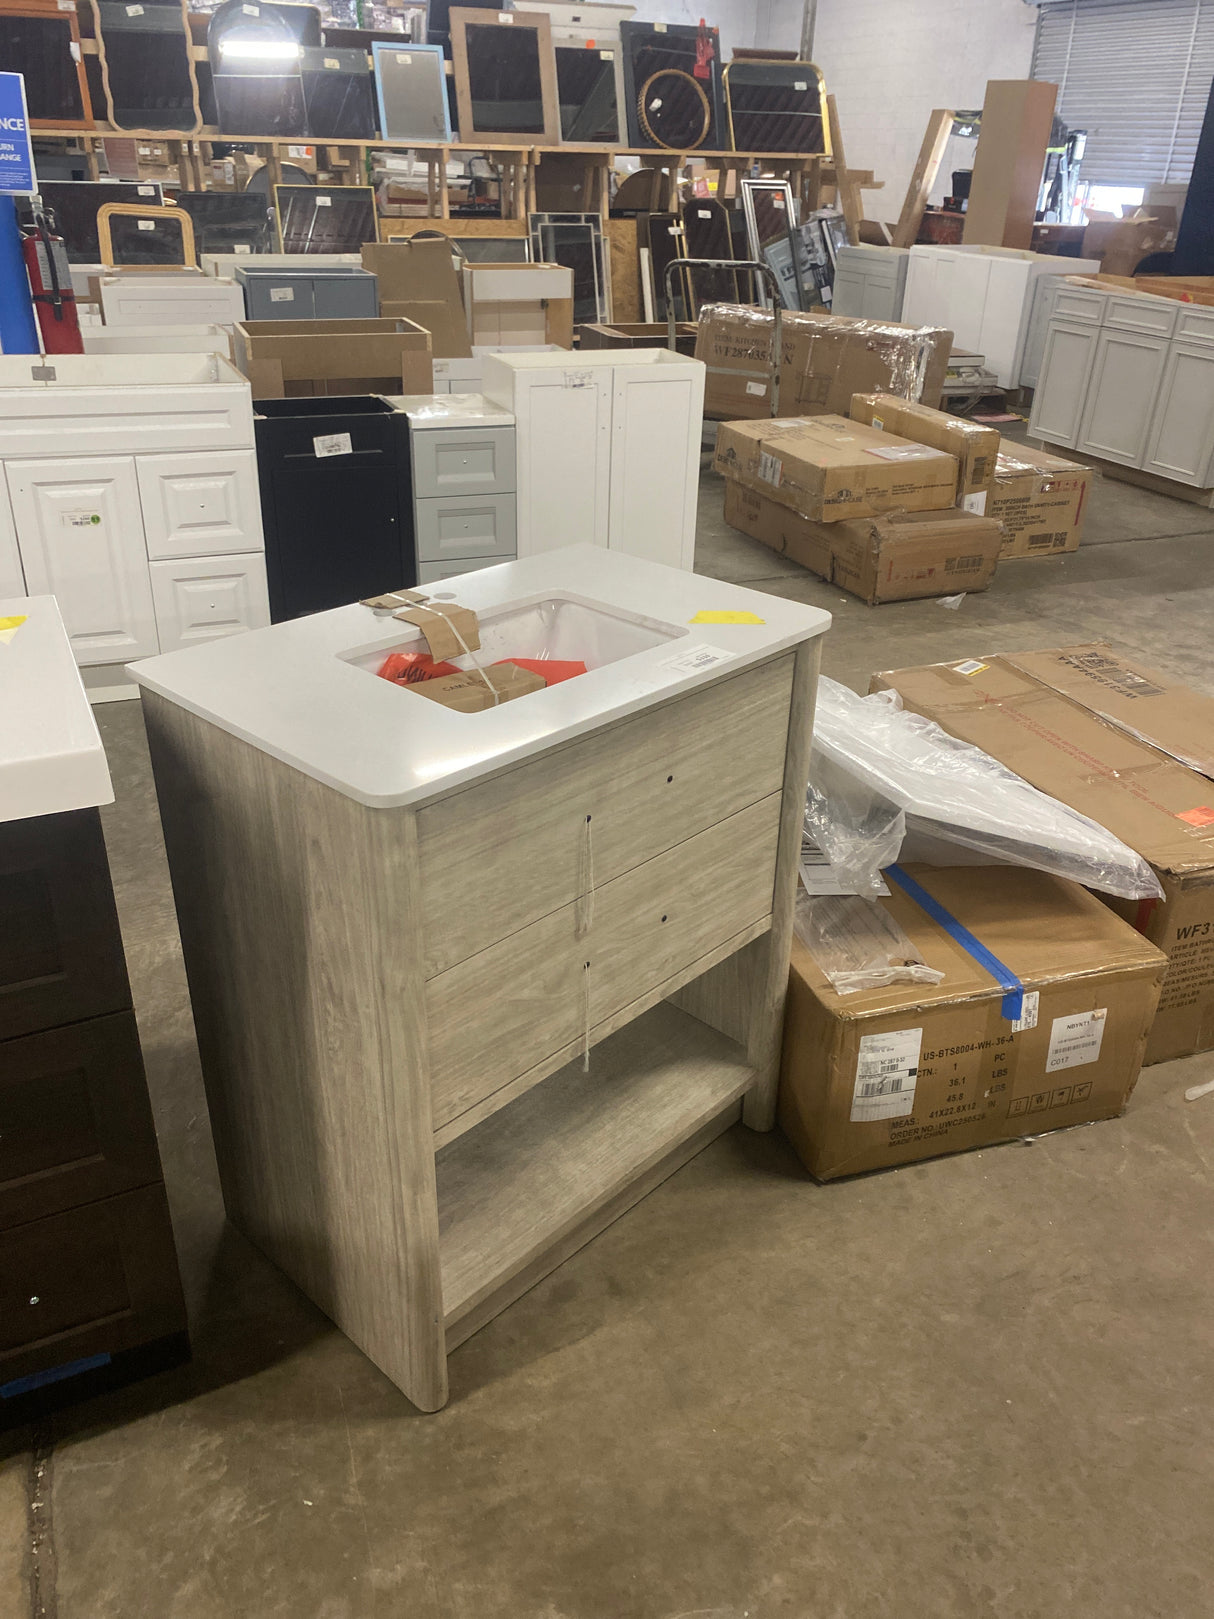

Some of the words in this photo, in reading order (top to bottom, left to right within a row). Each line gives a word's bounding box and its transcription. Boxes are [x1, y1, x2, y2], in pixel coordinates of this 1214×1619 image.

[994, 1053, 1006, 1062] PC
[991, 1068, 1008, 1079] LBS
[890, 1127, 920, 1141] ORDER
